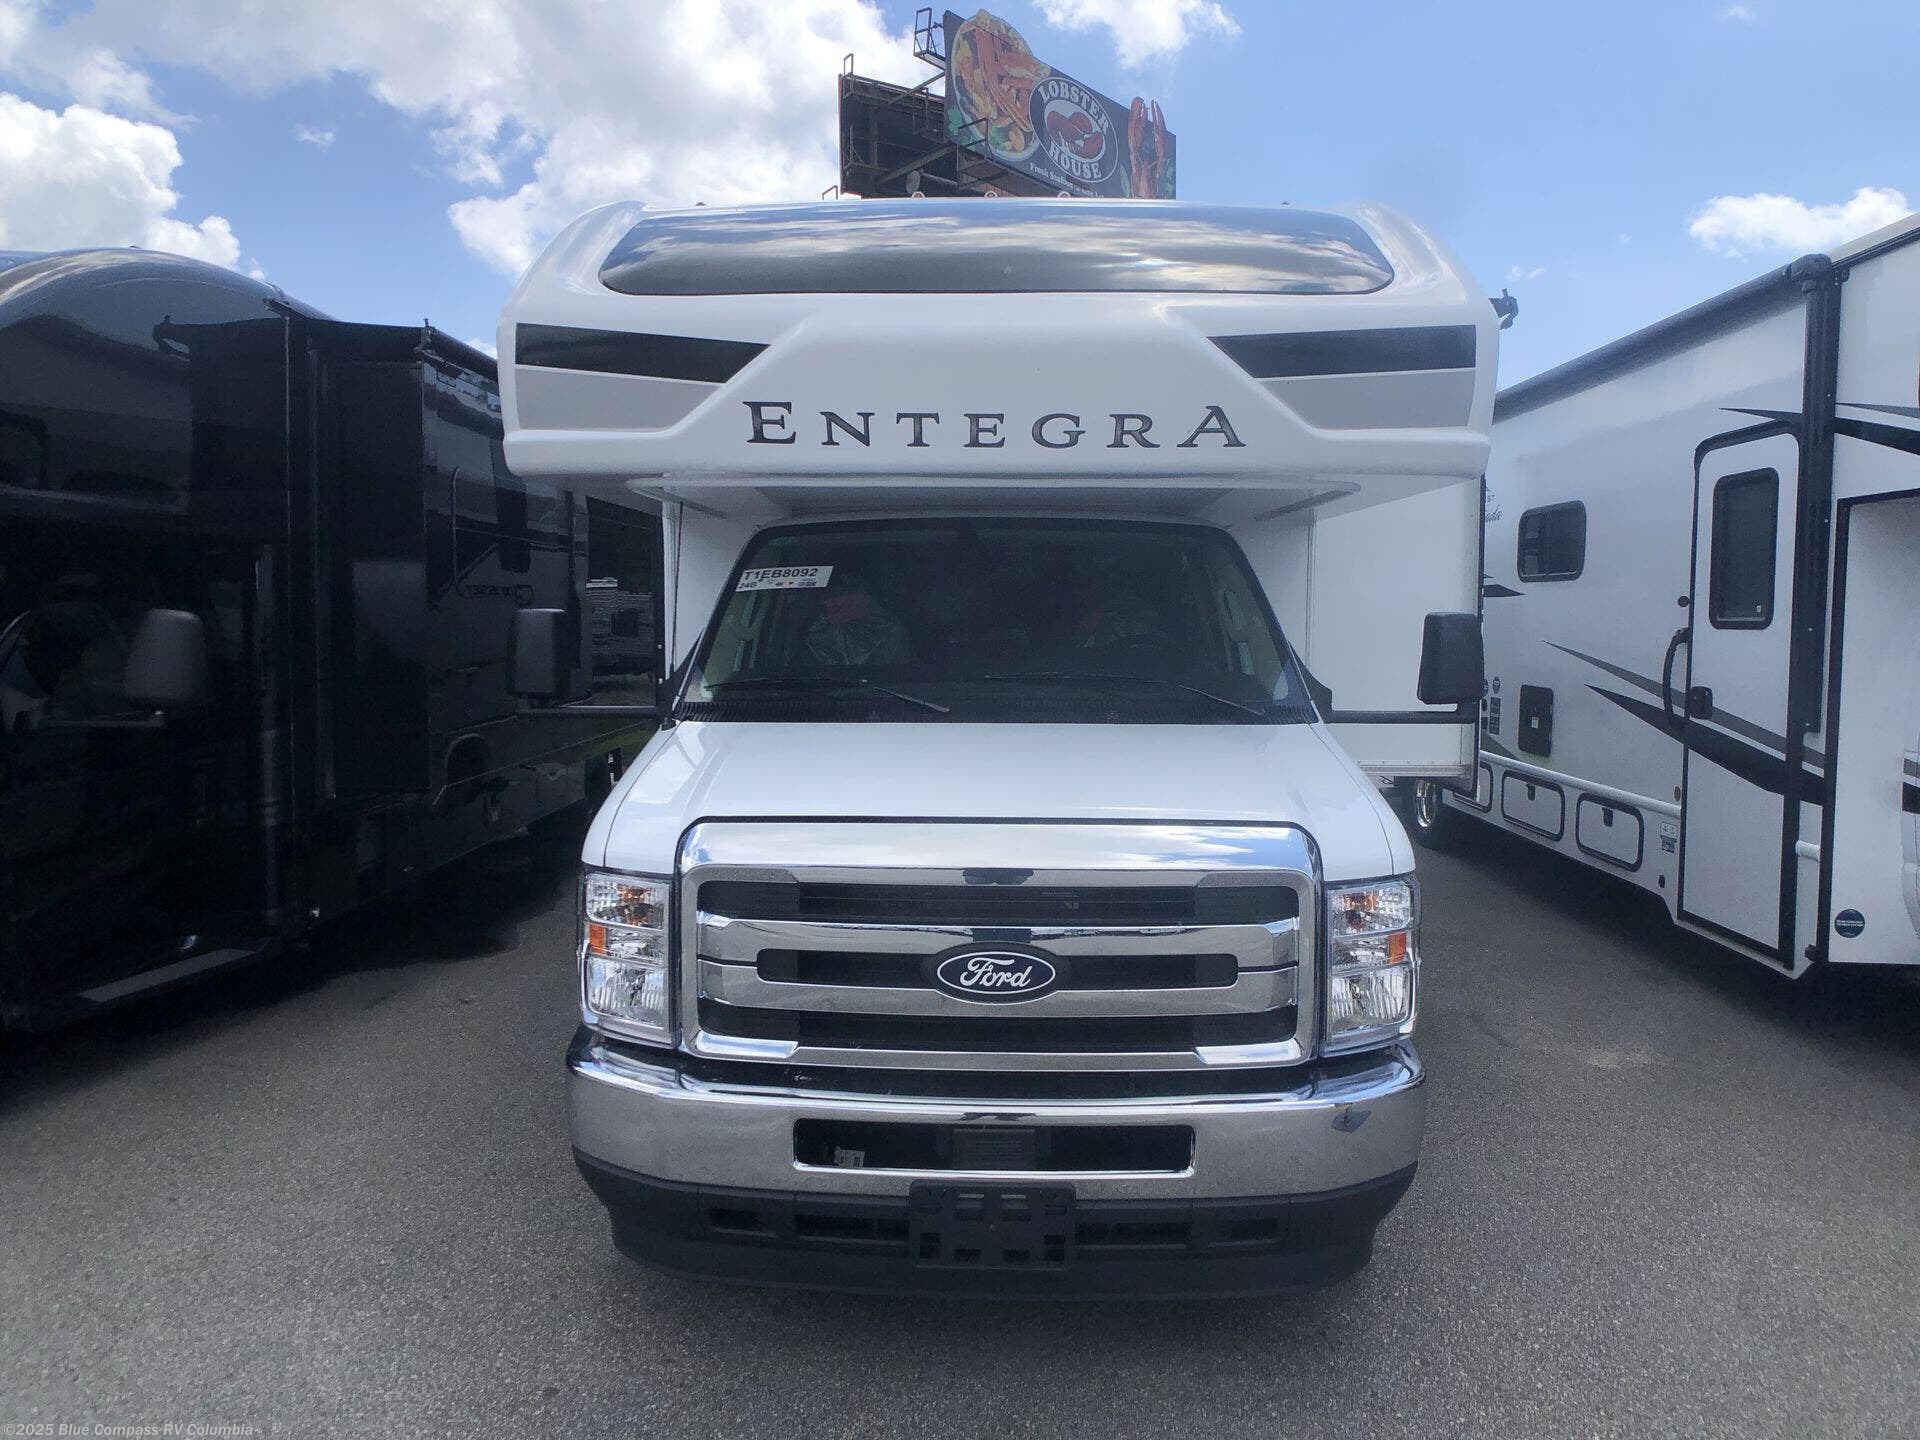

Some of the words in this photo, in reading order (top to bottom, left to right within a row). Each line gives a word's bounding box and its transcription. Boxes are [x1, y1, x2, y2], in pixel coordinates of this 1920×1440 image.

[1038, 80, 1109, 136] LOBSTER
[1049, 140, 1102, 179] HOUSE
[742, 401, 1247, 449] ENTEGRA
[744, 567, 818, 580] T1EB8092
[960, 957, 1033, 987] Ford
